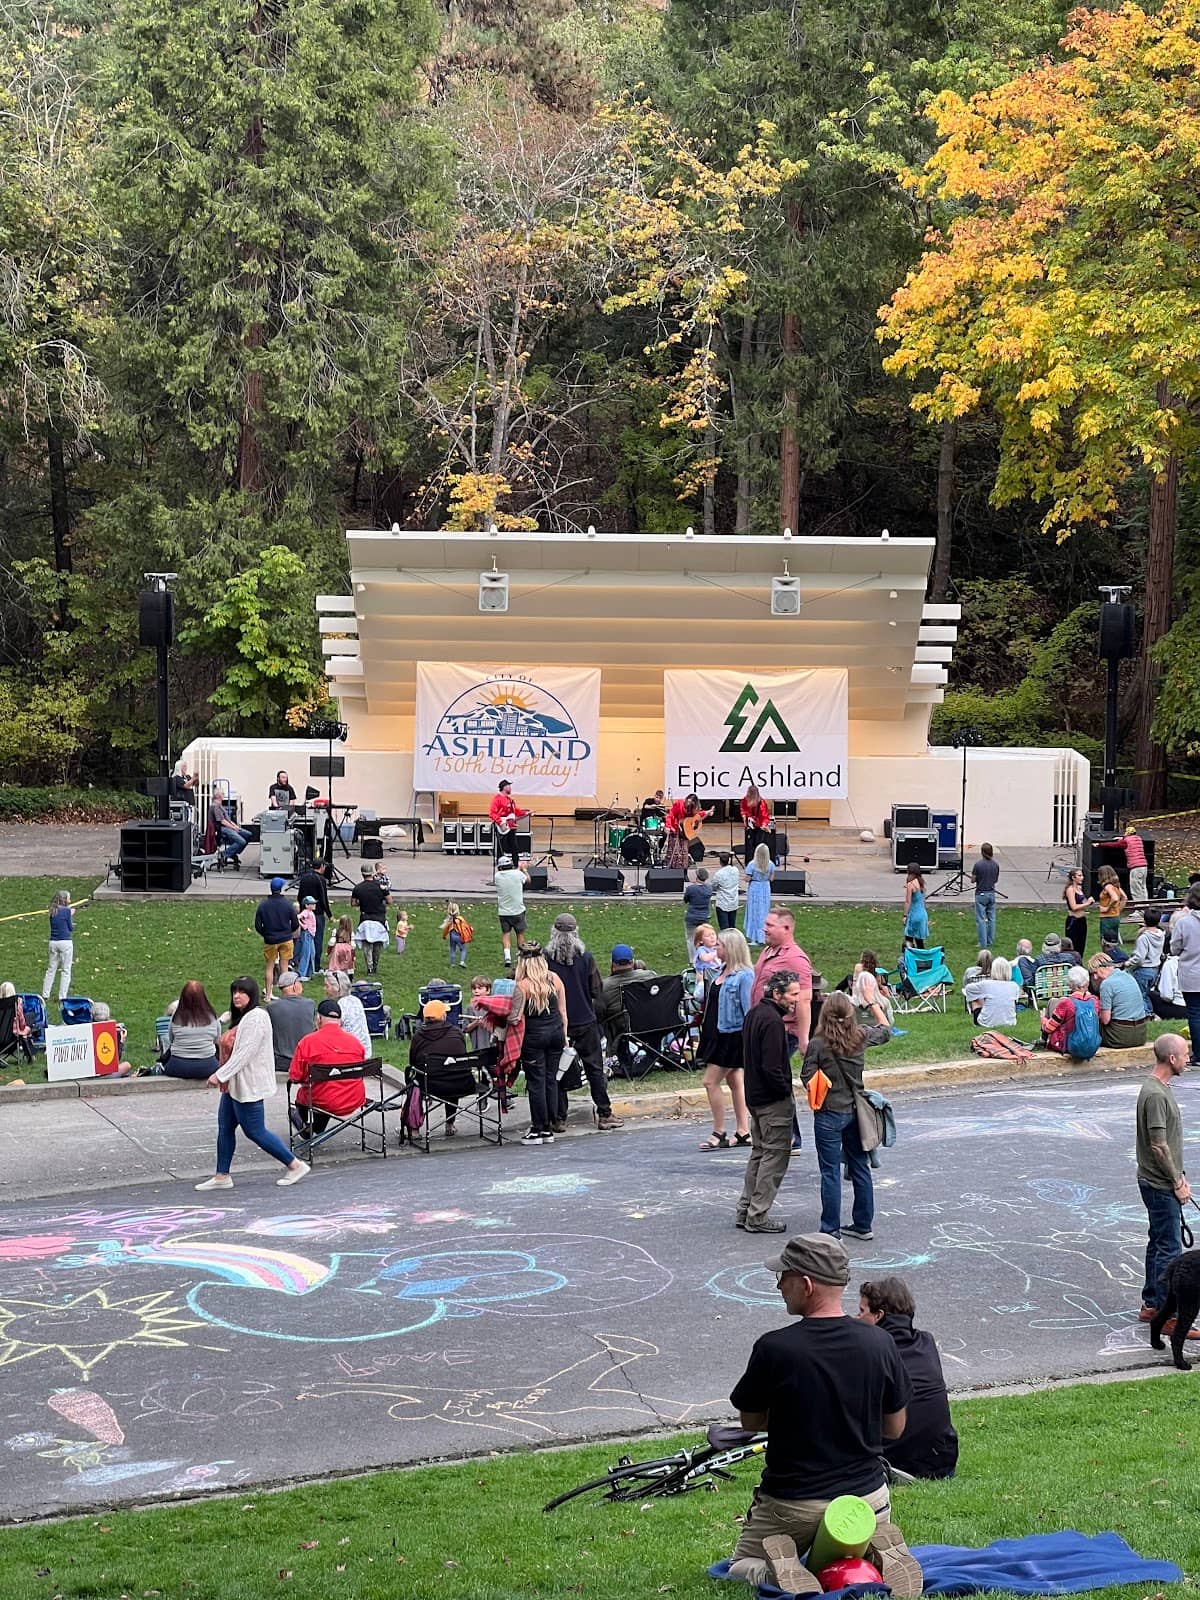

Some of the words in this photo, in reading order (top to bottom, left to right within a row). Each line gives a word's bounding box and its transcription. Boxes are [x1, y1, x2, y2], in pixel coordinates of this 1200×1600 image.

[422, 734, 592, 761] ASHLAND
[434, 751, 487, 775] 150th
[490, 752, 580, 787] Birthday!
[677, 765, 730, 793] Epic
[737, 764, 841, 788] Ashland
[54, 1046, 69, 1063] PWD
[71, 1044, 87, 1061] ONLY
